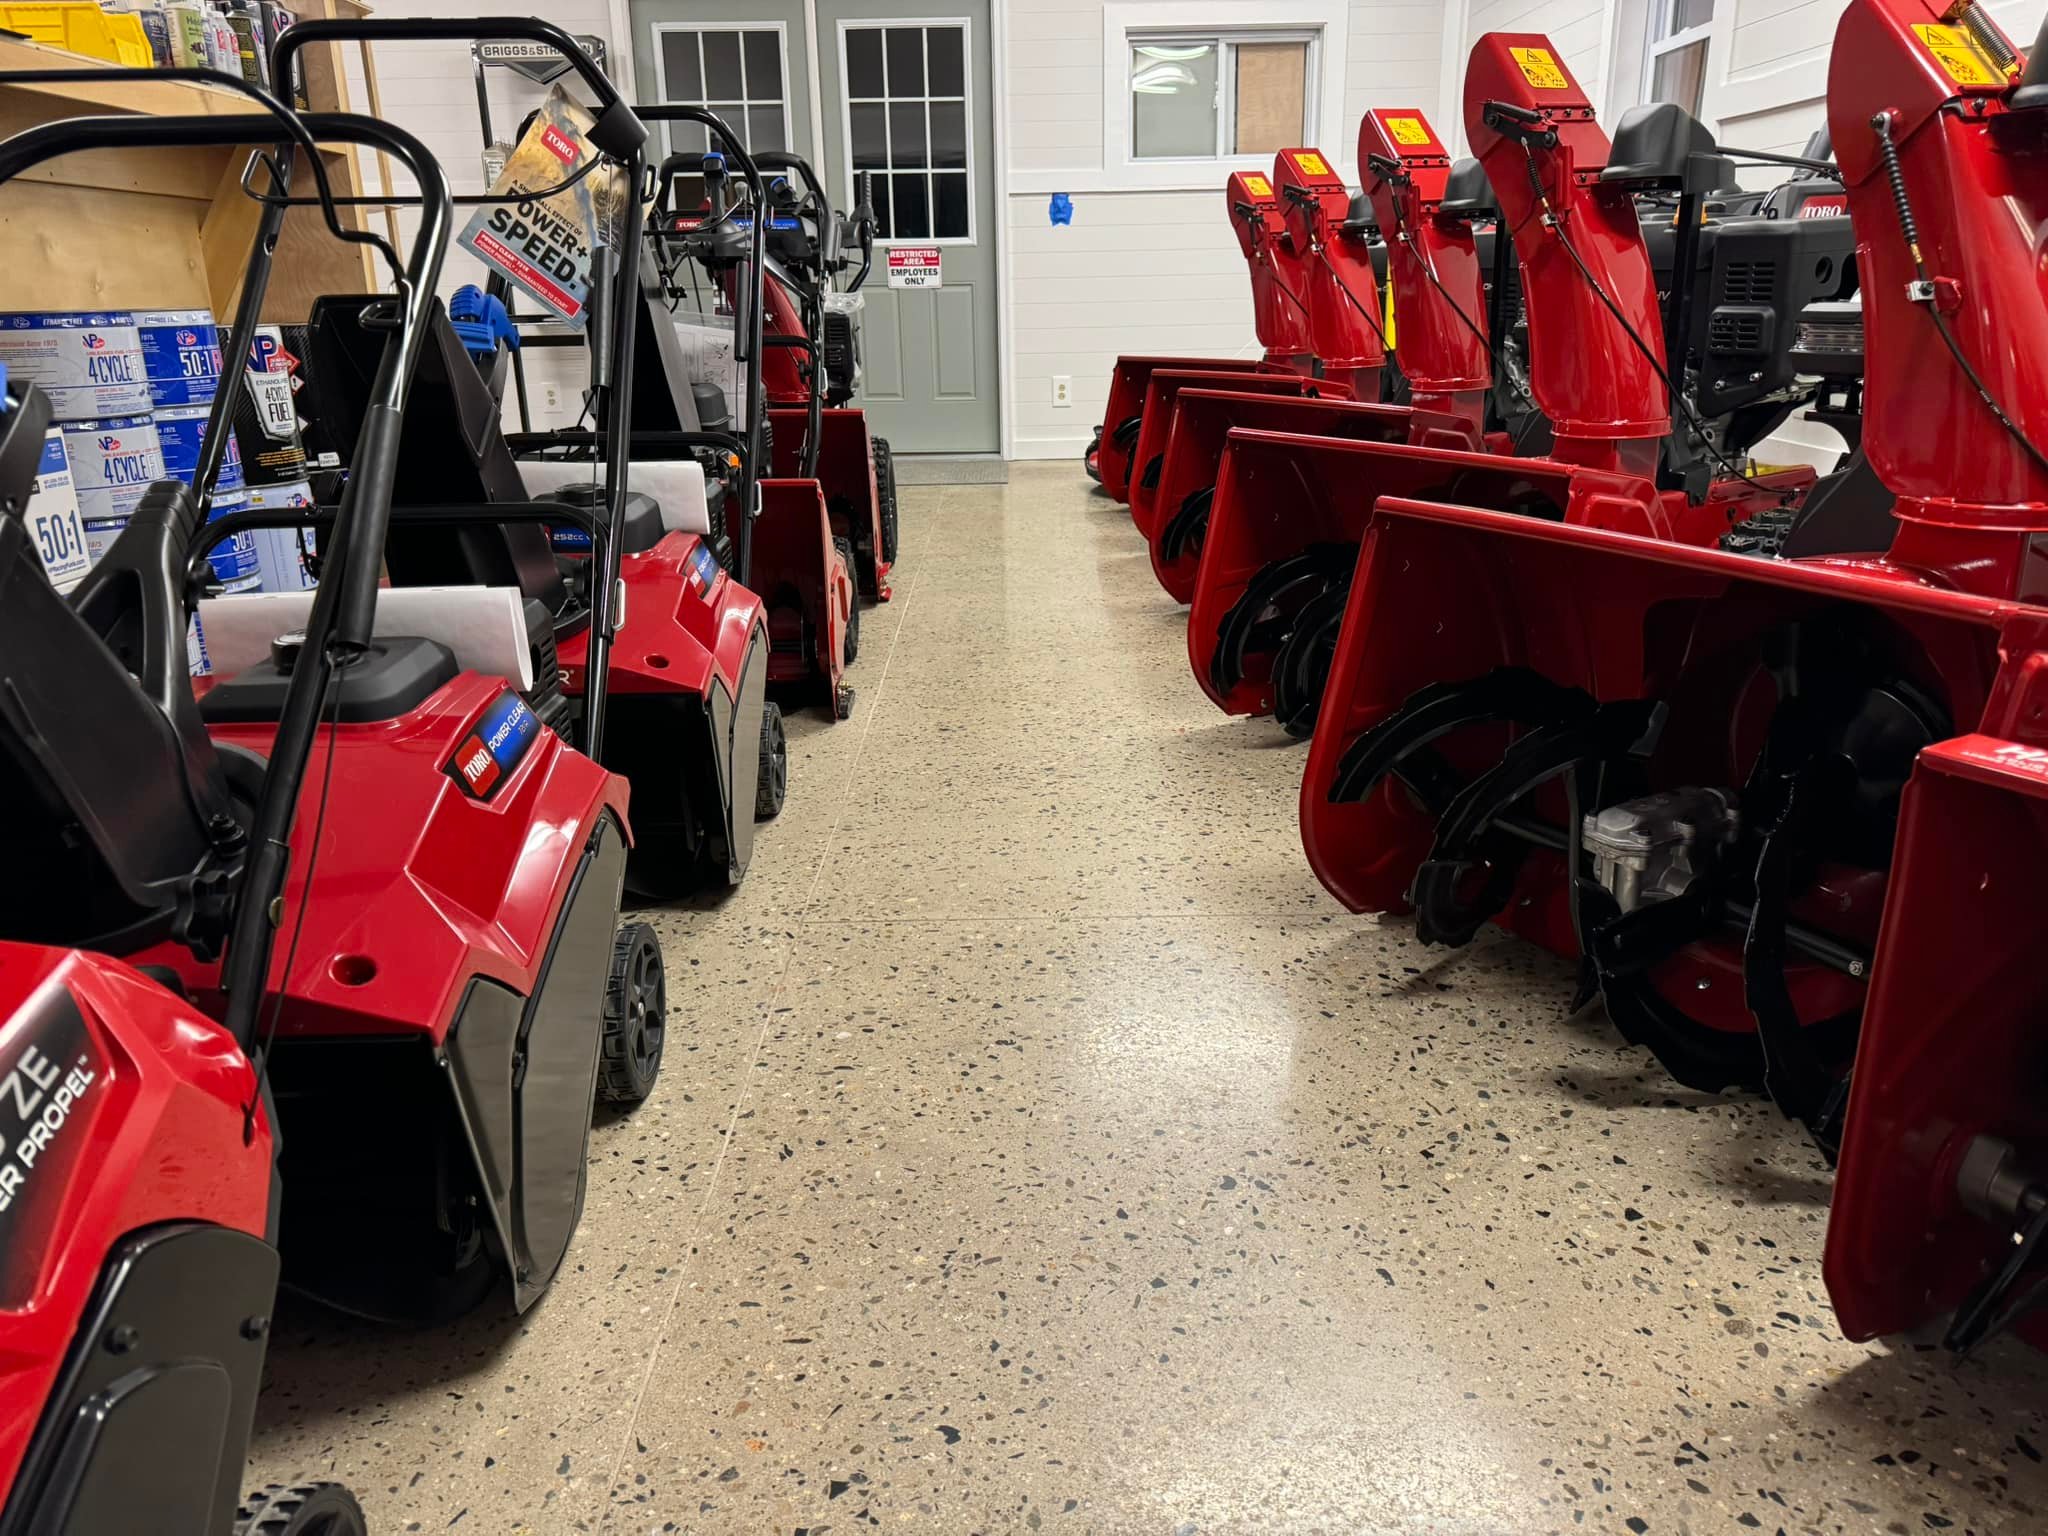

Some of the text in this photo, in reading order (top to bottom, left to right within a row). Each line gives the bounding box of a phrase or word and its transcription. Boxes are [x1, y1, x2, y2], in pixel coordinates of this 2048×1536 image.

[546, 130, 575, 160] TORO
[551, 209, 576, 231] EFFECT
[1803, 205, 1842, 218] TORO
[487, 207, 577, 290] SPEED.
[890, 250, 938, 258] RESTRICTED
[890, 267, 938, 277] EMPLOYEES
[903, 257, 925, 266] AREA
[904, 277, 926, 286] ONLY
[180, 351, 212, 377] 50:1
[268, 402, 293, 423] FUEL
[36, 509, 83, 564] 50:1
[487, 700, 527, 753] POWER CLEAR
[463, 747, 492, 784] TORO
